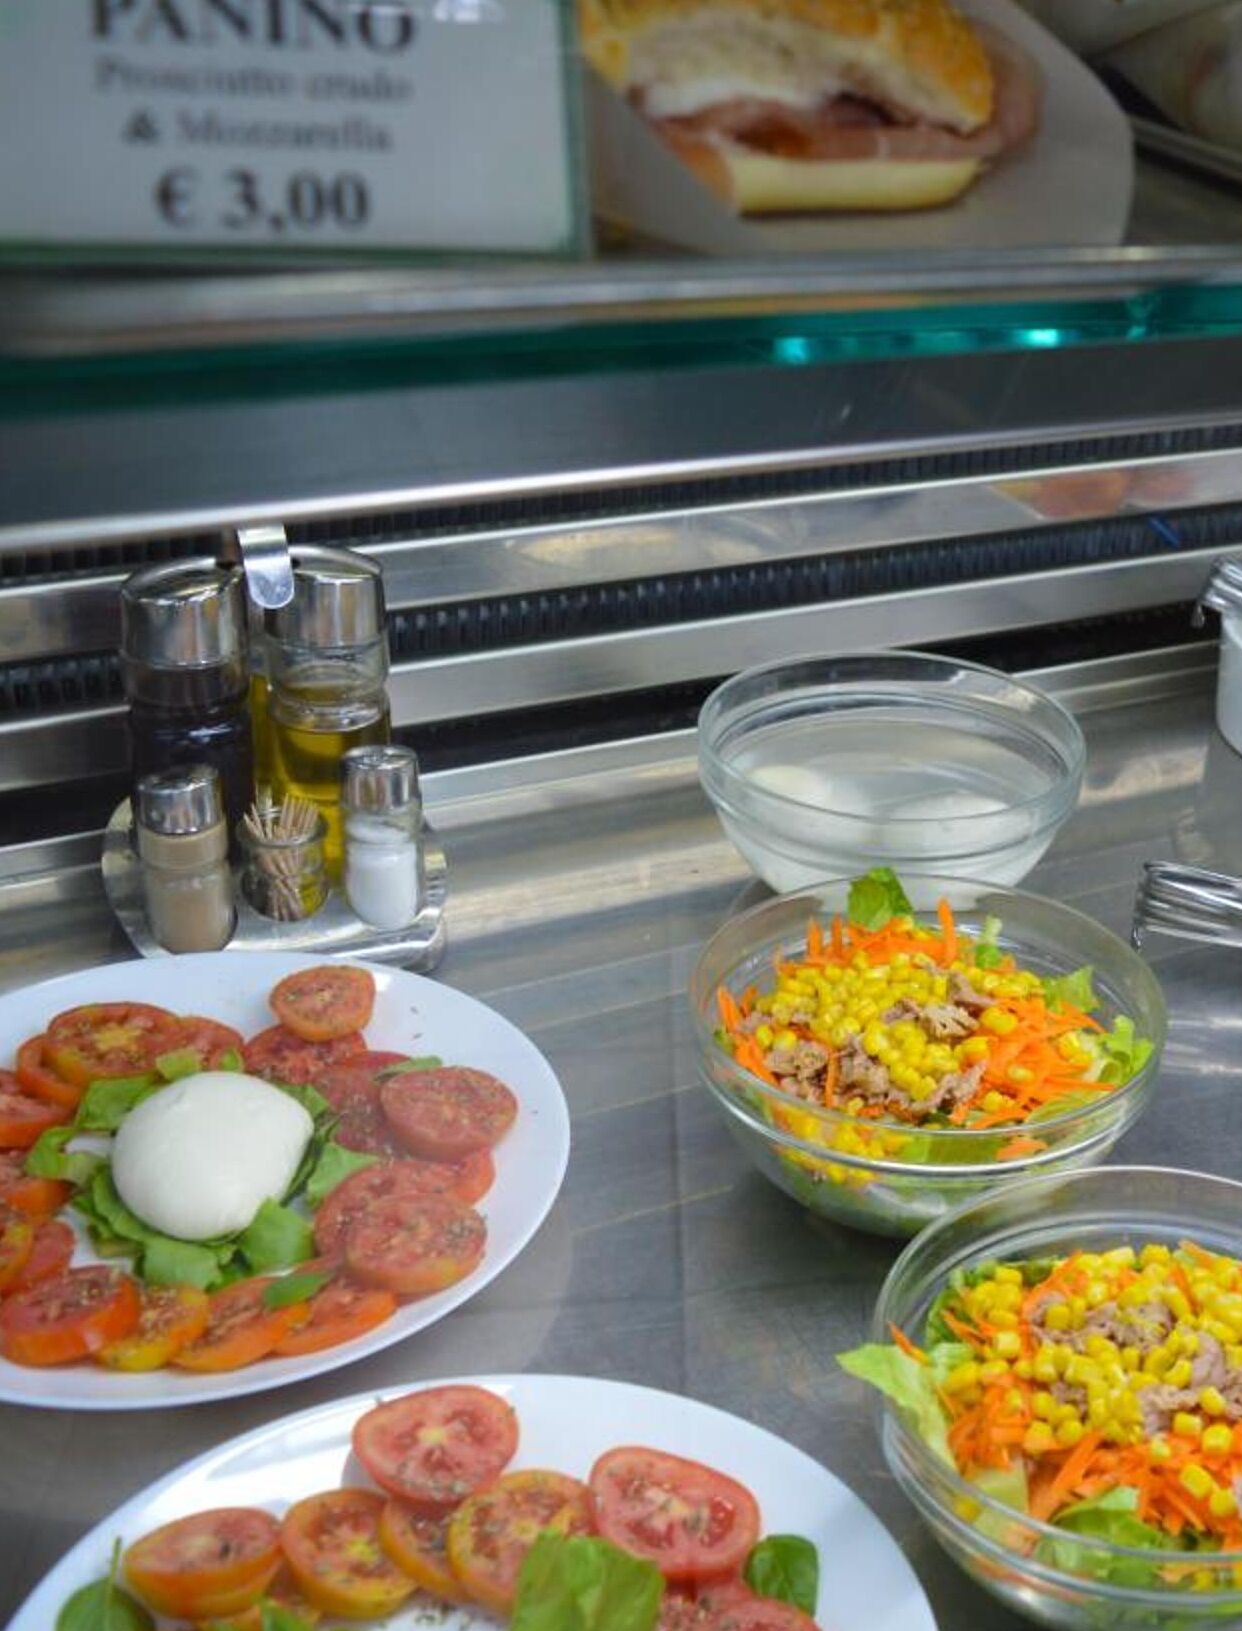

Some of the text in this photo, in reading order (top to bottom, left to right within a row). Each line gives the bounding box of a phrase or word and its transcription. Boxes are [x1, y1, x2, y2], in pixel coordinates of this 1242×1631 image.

[91, 0, 415, 56] PANINO
[122, 107, 159, 146] &
[154, 166, 371, 234] € 3,00
